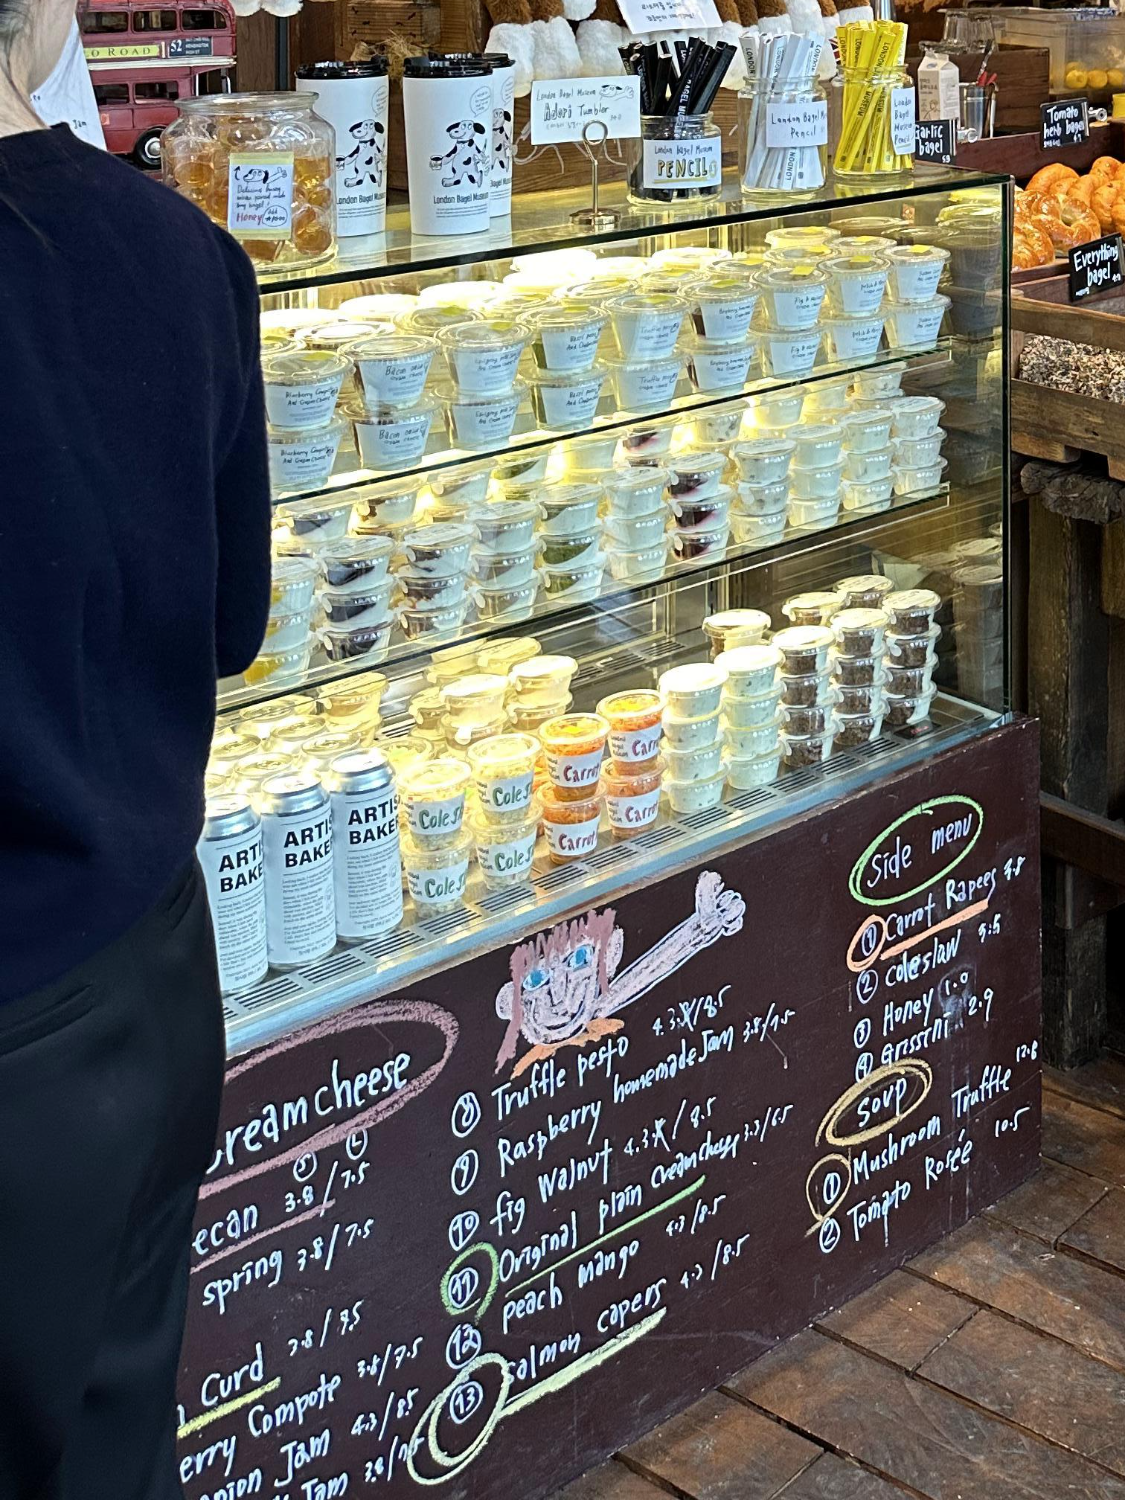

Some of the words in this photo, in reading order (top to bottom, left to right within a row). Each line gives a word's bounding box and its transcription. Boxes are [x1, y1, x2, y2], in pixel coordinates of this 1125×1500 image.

[108, 47, 151, 56] ROAD
[171, 40, 182, 52] 52
[772, 113, 801, 125] London
[791, 125, 816, 138] Pencil
[915, 124, 943, 140] Garlic
[1044, 123, 1061, 139] herb
[1047, 105, 1078, 124] Tomato
[658, 157, 708, 178] PENCIL
[786, 152, 796, 181] LONDON
[919, 139, 943, 156] bagel
[236, 212, 263, 225] Honey
[1073, 243, 1119, 272] Everything
[1087, 262, 1110, 287] bagel
[867, 836, 912, 888] Side
[931, 813, 972, 854] menu
[885, 893, 936, 941] Carrot
[883, 988, 934, 1036] Honey
[969, 988, 994, 1021] 2.9
[492, 1061, 567, 1122] Truffle
[577, 1037, 629, 1085] pesto
[498, 1099, 602, 1177] Raspberry
[614, 1044, 696, 1103] homemade
[698, 1025, 734, 1062] Jam
[853, 1115, 941, 1184] Mushroom
[952, 1065, 1012, 1118] Truffle
[539, 1139, 613, 1203] Walnut
[193, 1204, 259, 1256] ecan
[847, 1181, 911, 1242] Tomato
[500, 1211, 577, 1282] Original
[599, 1184, 643, 1234] plain
[503, 1272, 563, 1334] peach
[578, 1240, 640, 1288] mango
[597, 1278, 667, 1333] capers
[248, 1373, 341, 1437] Compote
[275, 1429, 331, 1487] Jam
